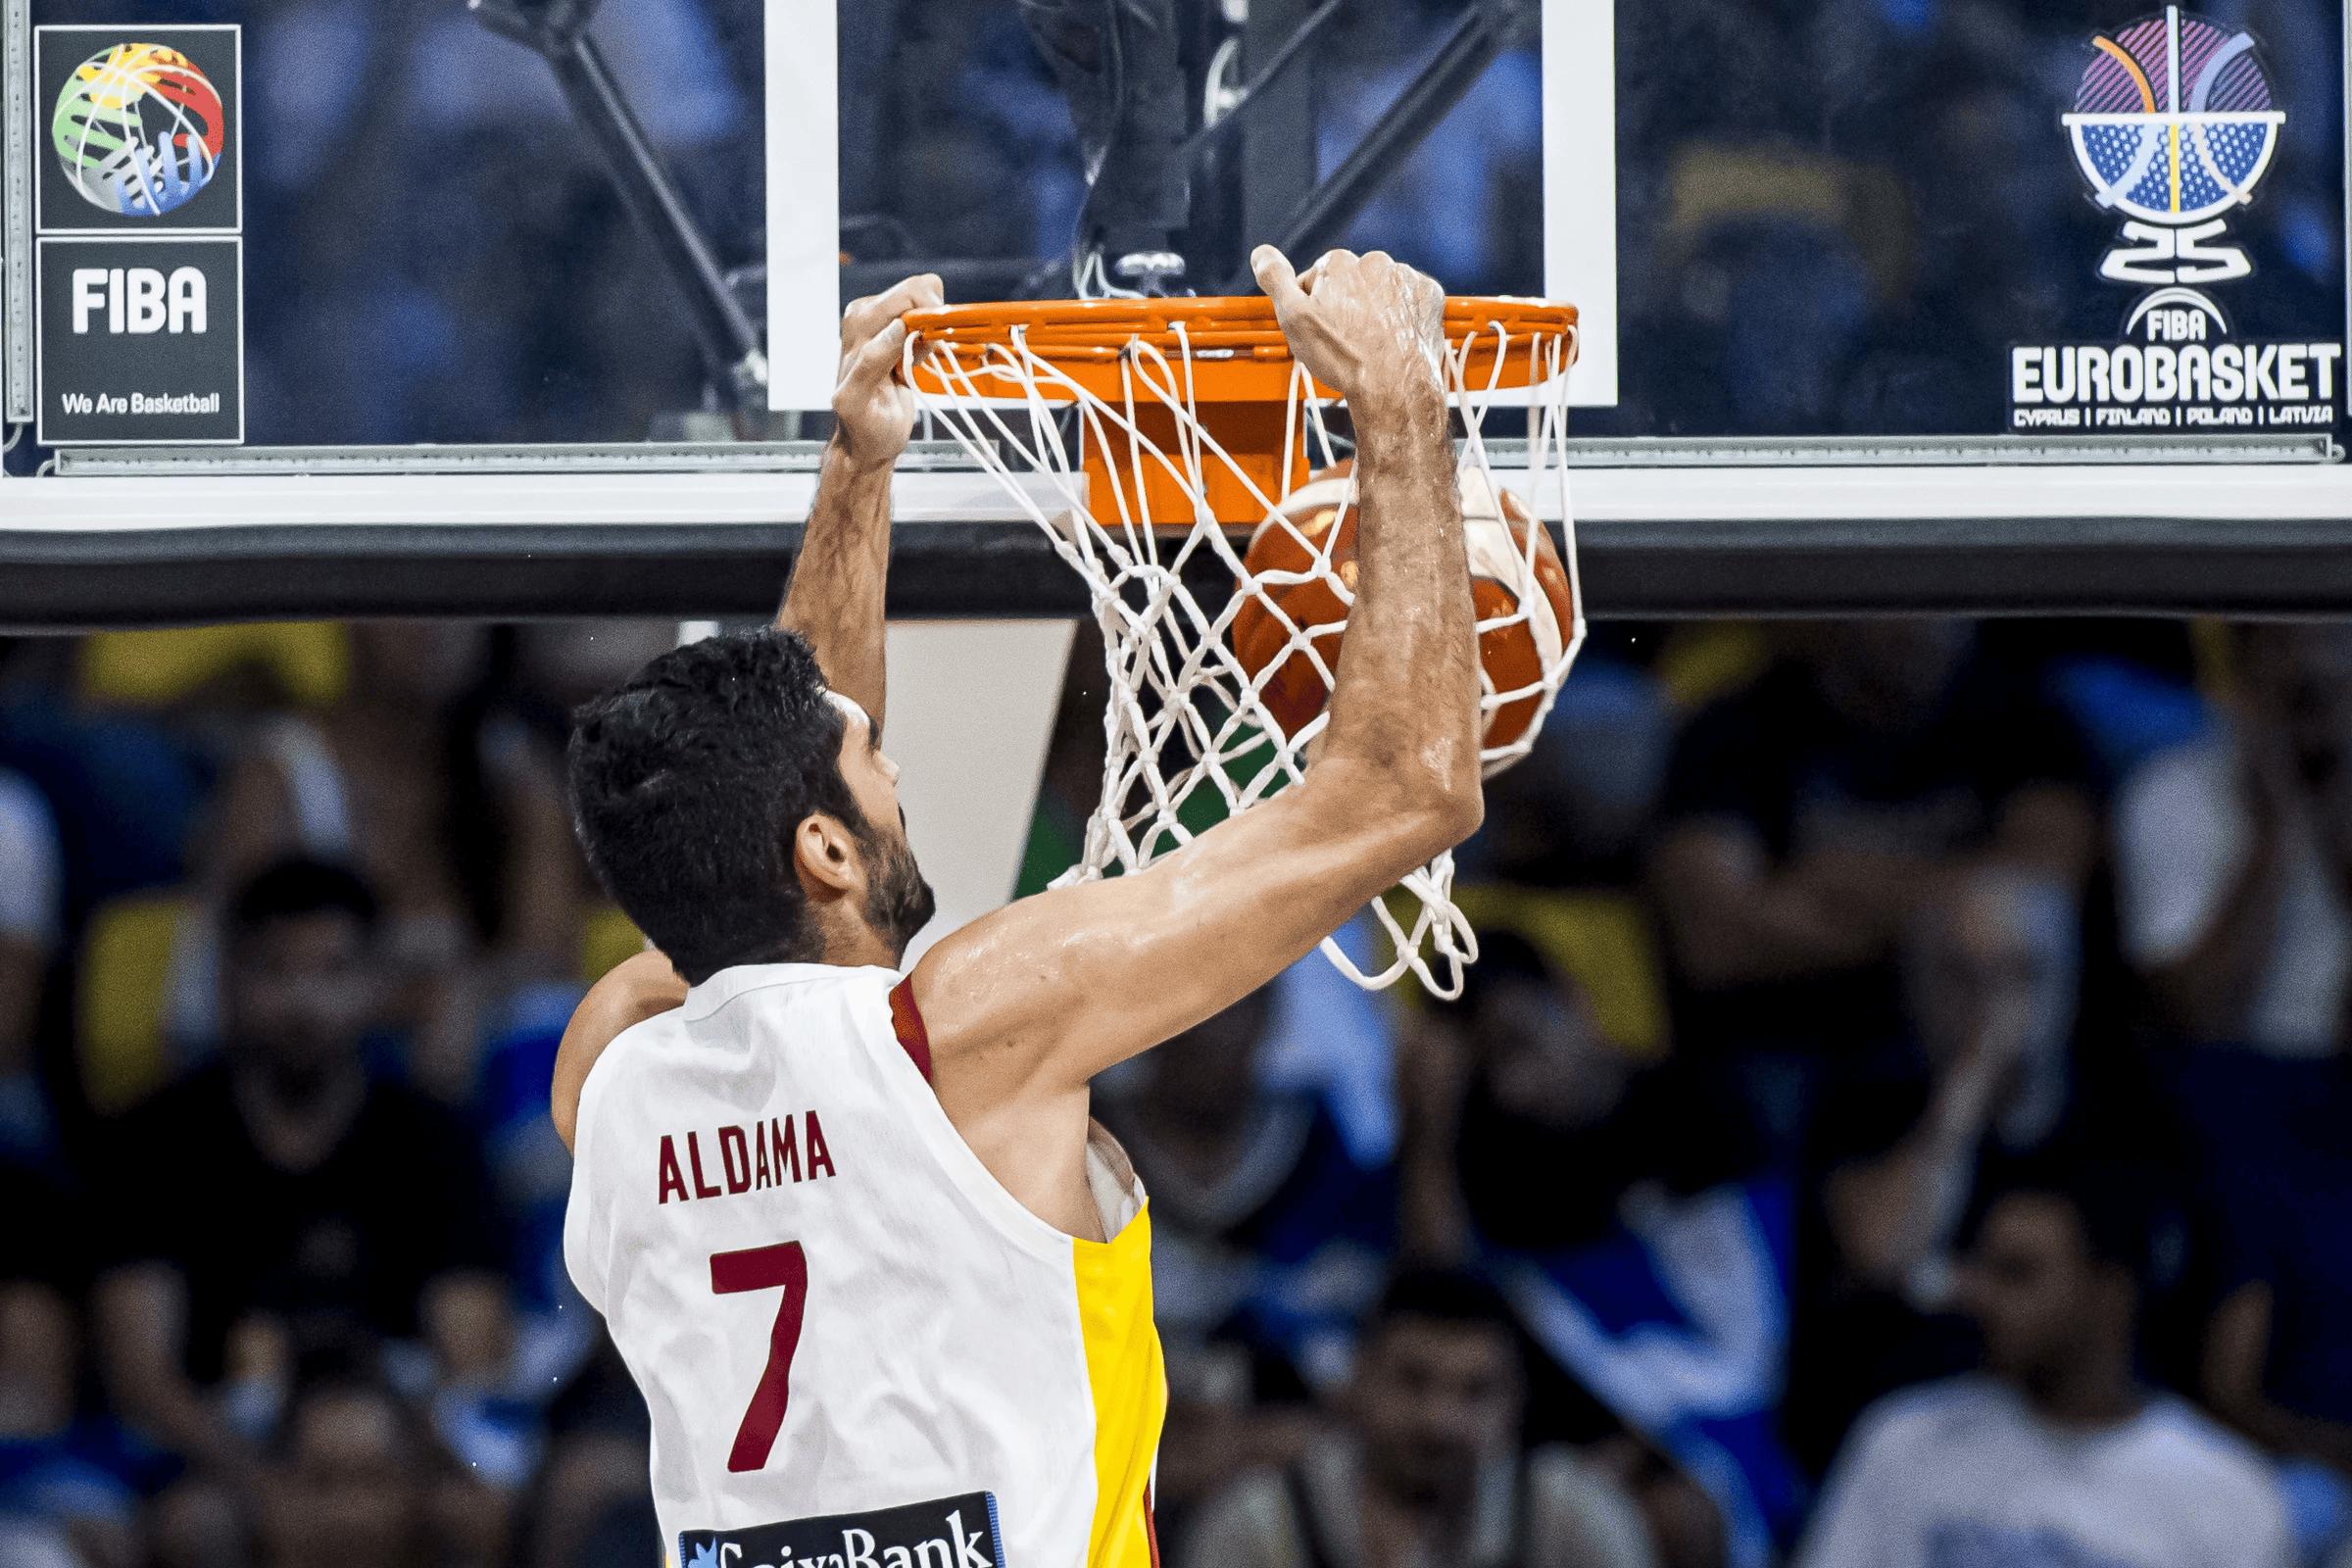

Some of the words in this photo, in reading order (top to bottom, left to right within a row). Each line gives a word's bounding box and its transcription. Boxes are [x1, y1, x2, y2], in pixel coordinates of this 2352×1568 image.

[73, 266, 208, 334] FIBA
[2146, 309, 2206, 341] FIBA
[62, 392, 93, 415] We
[96, 392, 128, 415] Are
[130, 392, 220, 415] Basketball
[2012, 343, 2341, 404] EUROBASKET
[2013, 408, 2080, 427] CYPRUS
[2095, 407, 2171, 426] FINLAND
[2186, 407, 2253, 425] POLAND
[2269, 405, 2333, 424] LATVIA
[658, 1109, 836, 1204] ALDAMA
[710, 1240, 808, 1473] 7
[719, 1509, 994, 1568] CiBank
